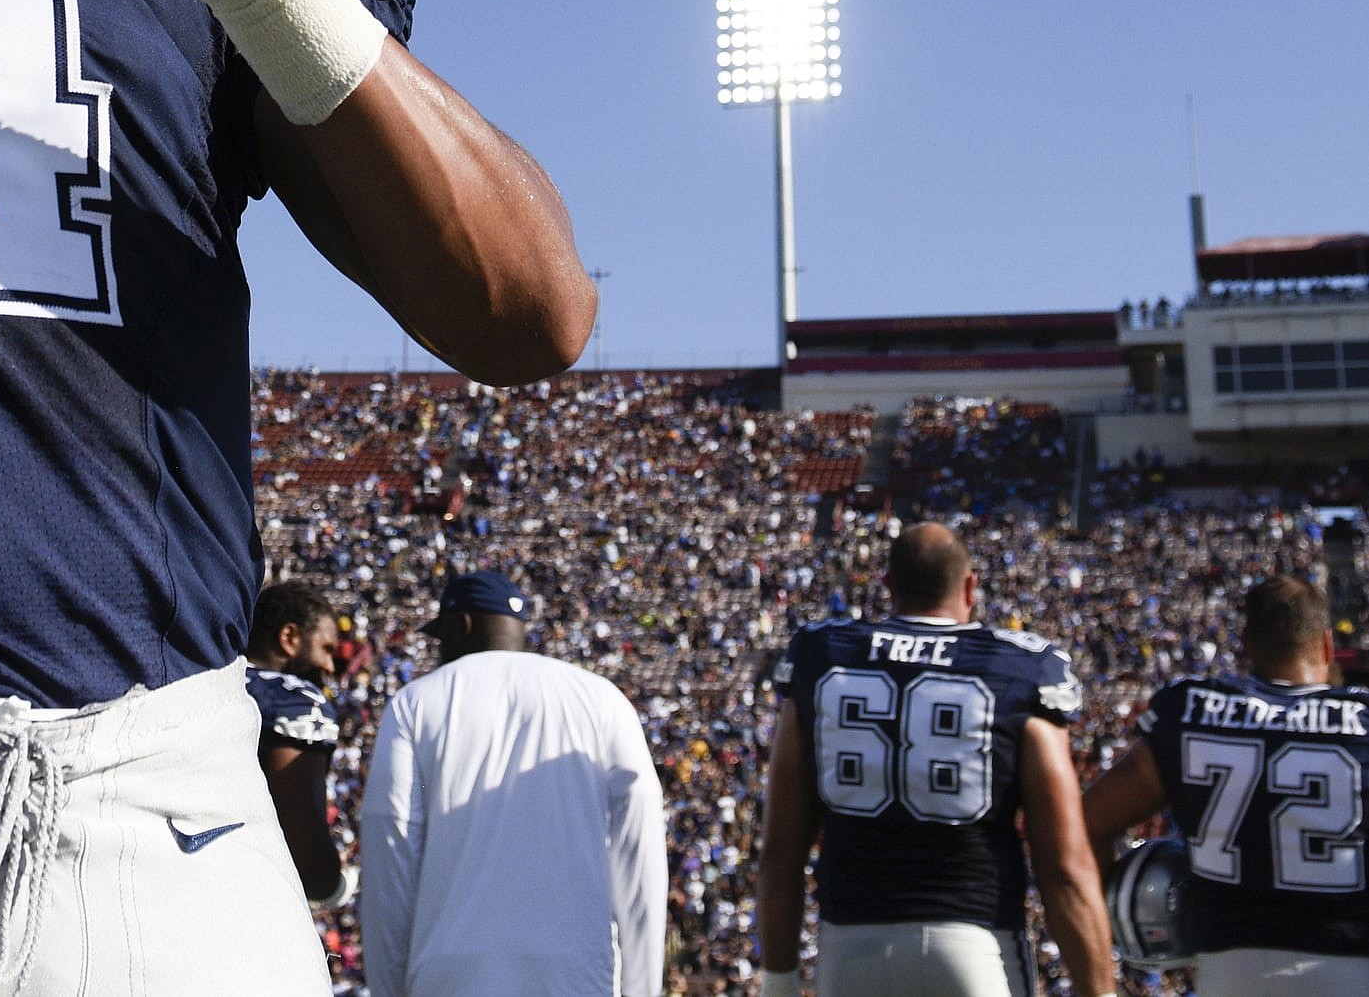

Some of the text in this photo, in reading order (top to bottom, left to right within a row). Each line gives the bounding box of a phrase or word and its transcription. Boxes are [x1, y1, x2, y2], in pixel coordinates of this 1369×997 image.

[868, 631, 959, 667] FREE
[813, 665, 996, 826] 68
[1181, 686, 1369, 737] FREDERICK
[1180, 730, 1366, 894] 72
